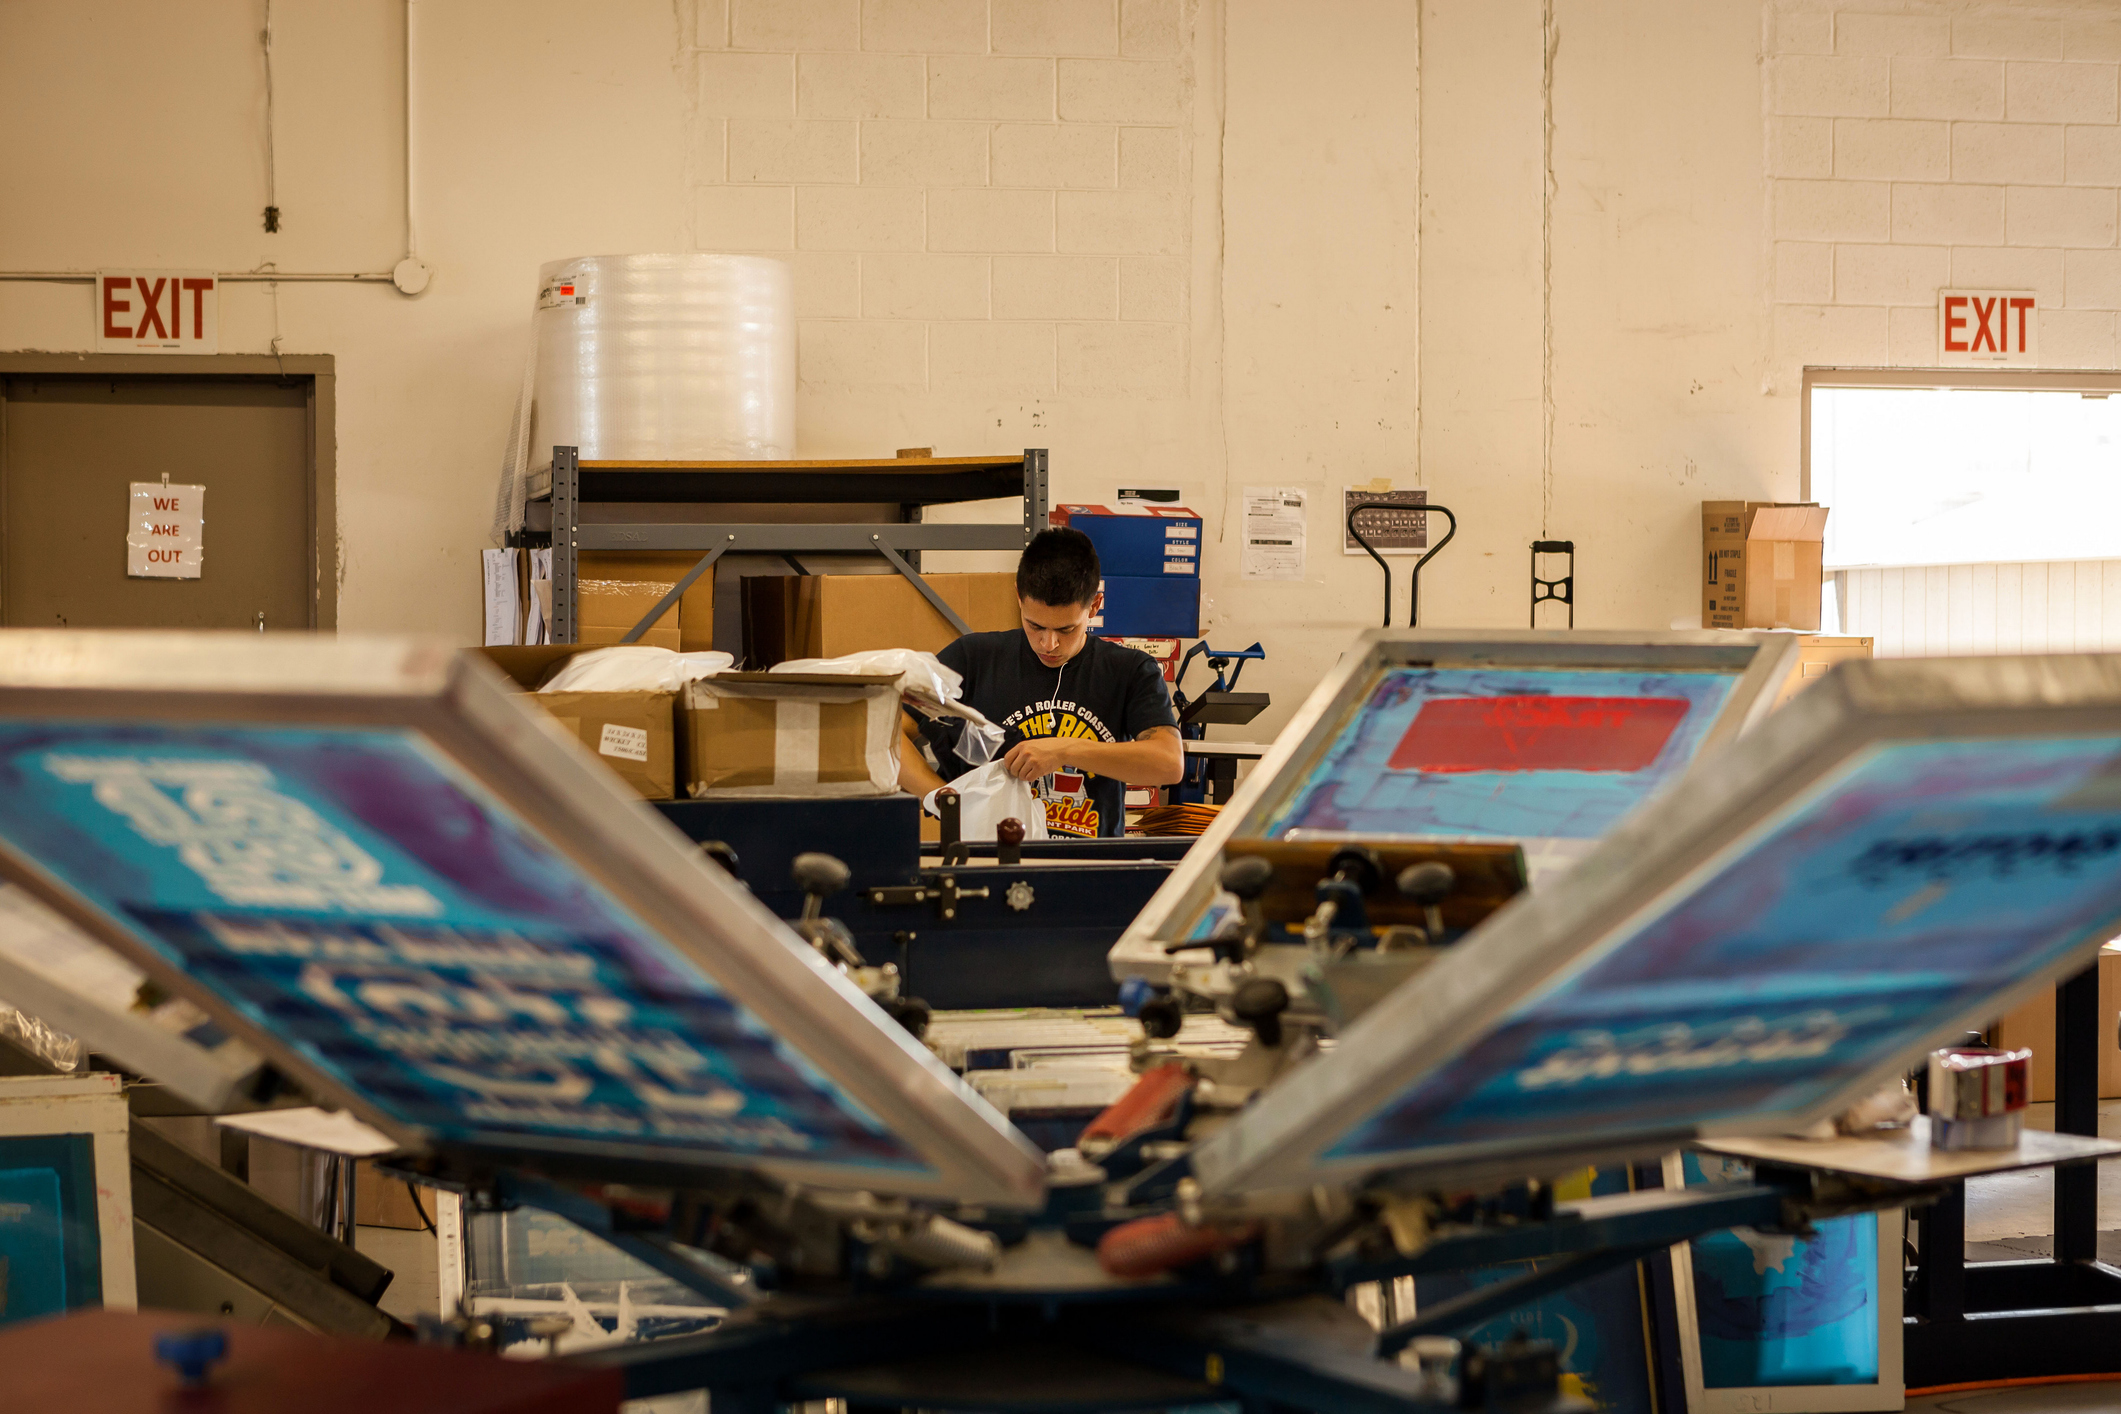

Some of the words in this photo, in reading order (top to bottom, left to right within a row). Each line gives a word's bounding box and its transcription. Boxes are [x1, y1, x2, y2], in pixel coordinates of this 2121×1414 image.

[103, 276, 214, 340] EXIT
[1944, 296, 2036, 354] EXIT
[153, 497, 180, 511] WE
[151, 524, 180, 537] ARE
[147, 549, 183, 563] OUT
[1018, 712, 1054, 739] THE
[1025, 705, 1034, 716] A
[1035, 700, 1077, 712] ROLLER
[1077, 706, 1116, 743] COASTER
[1064, 824, 1092, 835] PARK
